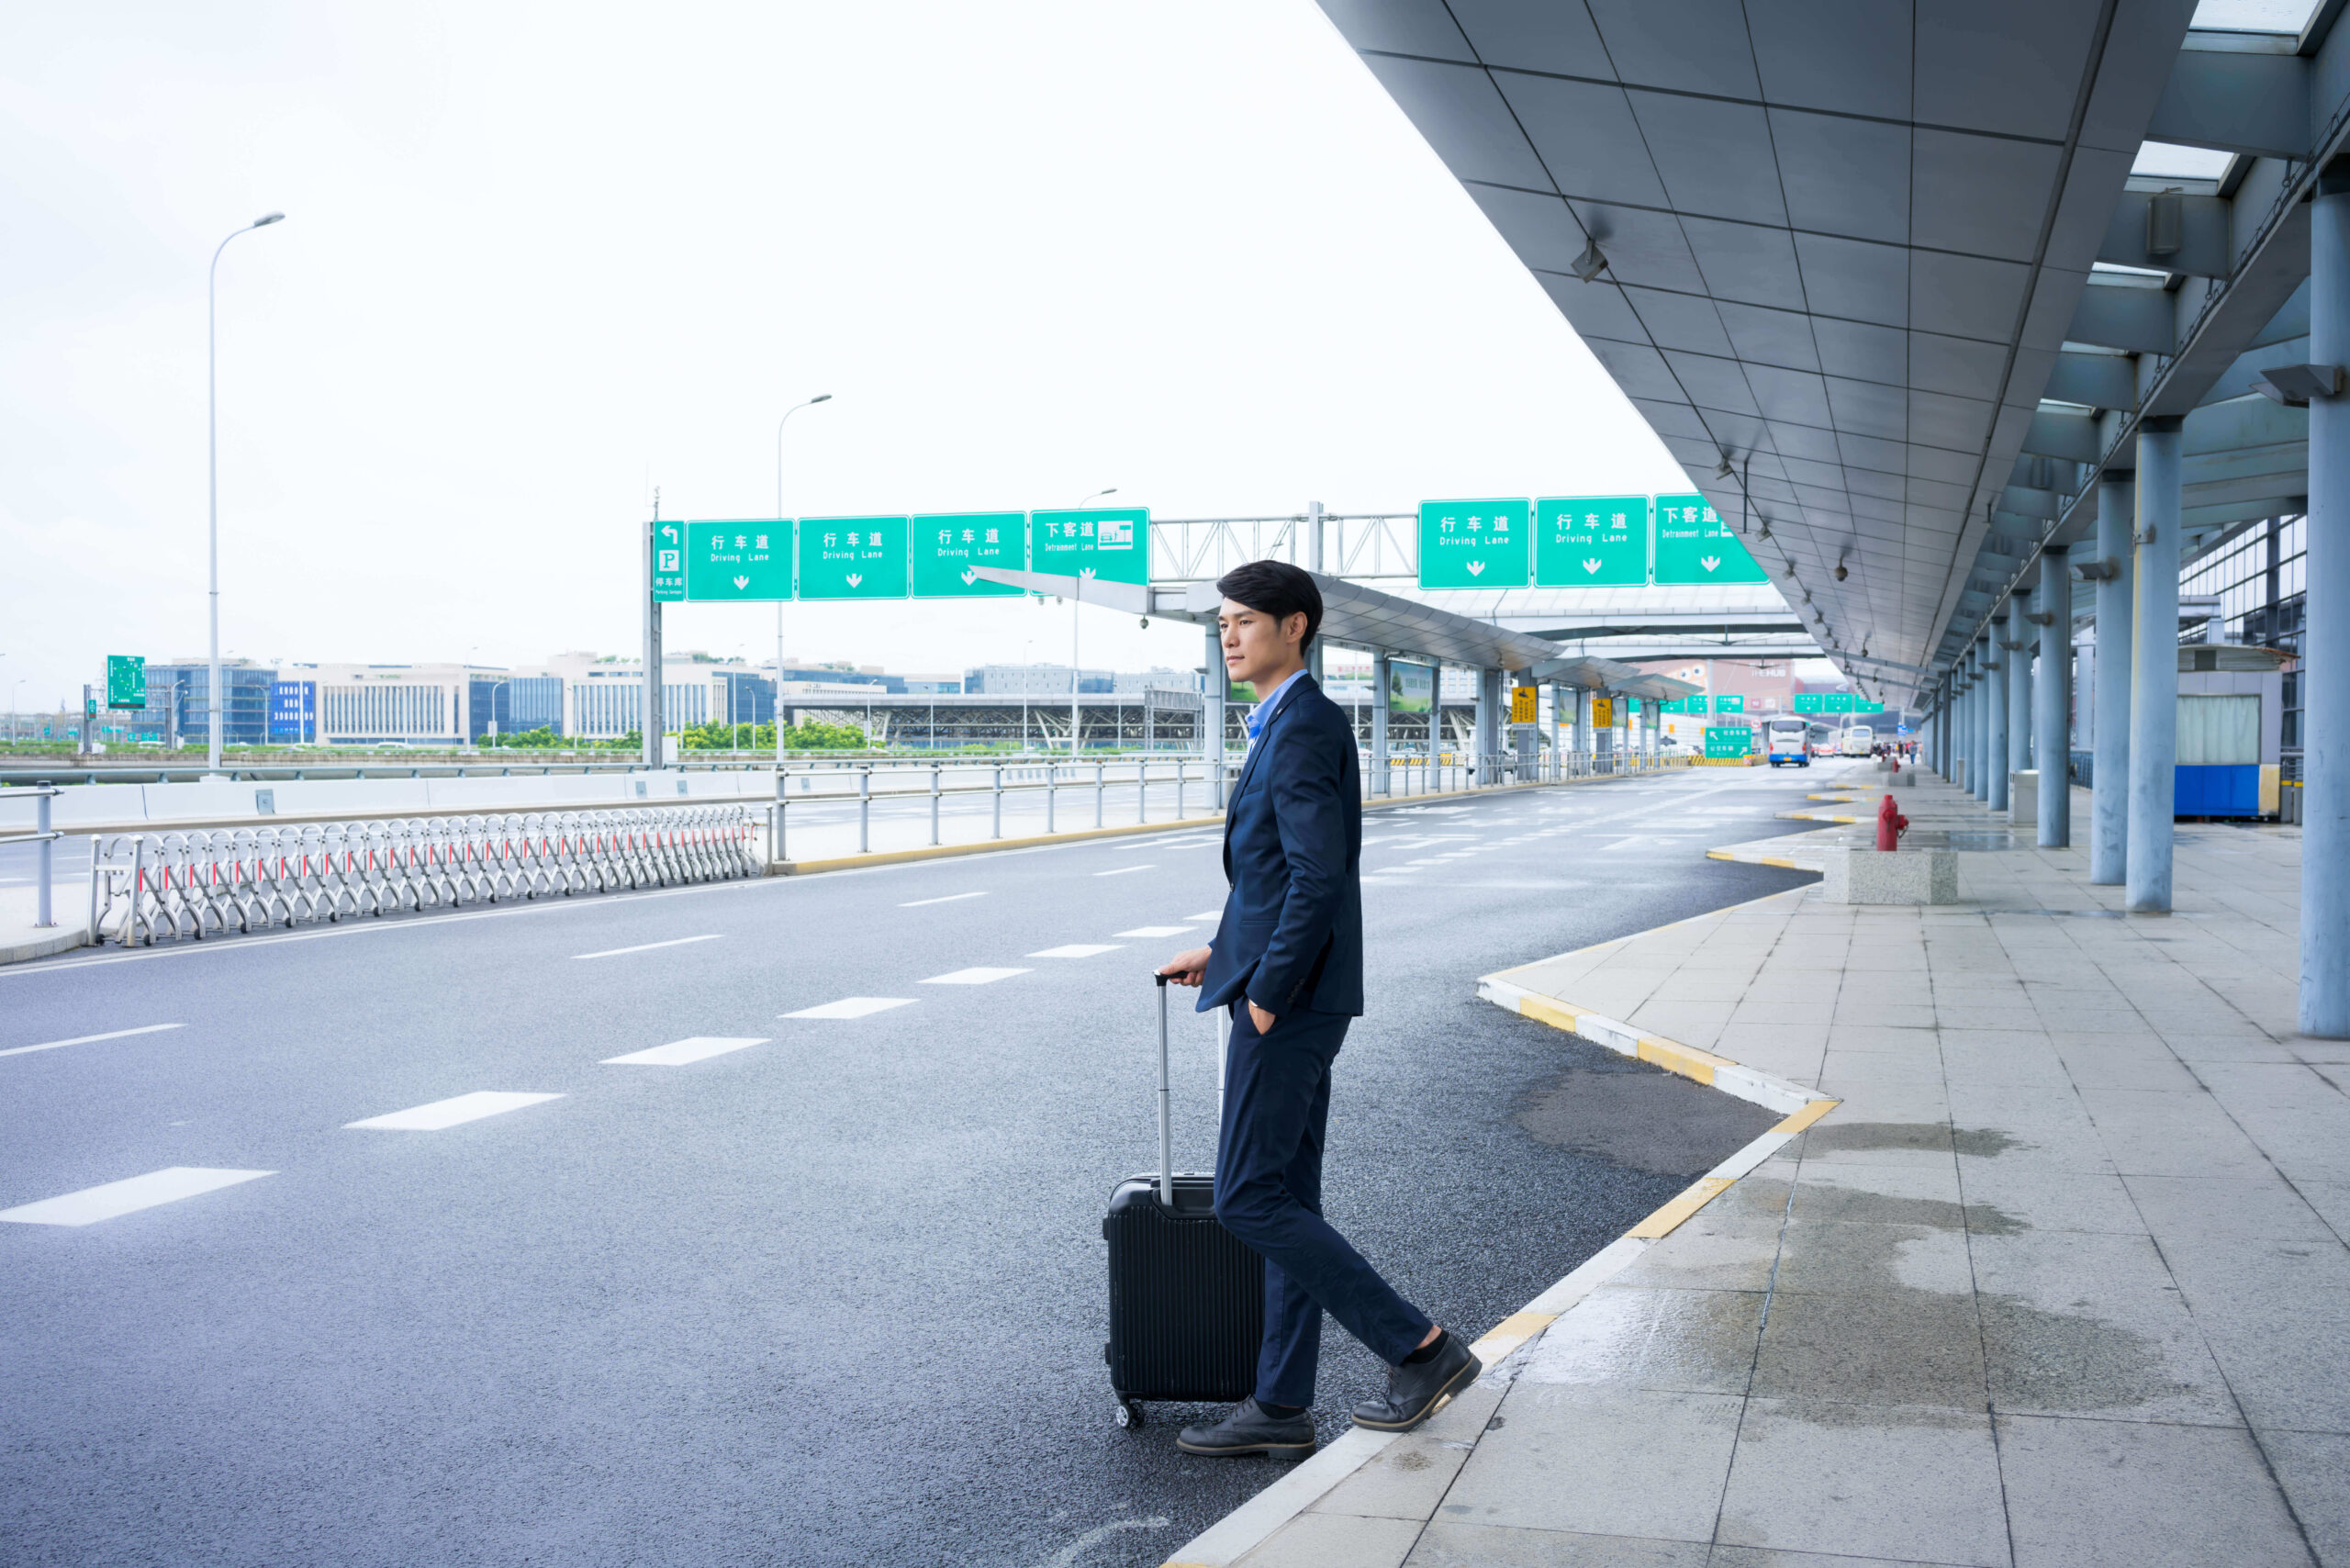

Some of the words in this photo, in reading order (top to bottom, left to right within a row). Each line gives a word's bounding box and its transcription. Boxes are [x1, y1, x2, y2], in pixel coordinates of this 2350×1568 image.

[1556, 512, 1628, 531] 行车道
[1662, 506, 1718, 523] 下客道
[1045, 521, 1094, 538] 下客道
[1440, 515, 1509, 532] 行车道
[823, 532, 882, 548] 行车道
[938, 528, 1000, 544] 行车道
[1439, 536, 1476, 547] Driving
[1484, 535, 1509, 544] Lane
[1556, 533, 1592, 545] Driving
[1602, 532, 1628, 543] Lane
[1705, 529, 1718, 538] Lane
[711, 534, 769, 550] 行车道
[1080, 543, 1094, 551] Lane
[711, 553, 741, 564] Driving
[748, 553, 769, 562] Lane
[822, 551, 855, 561] Driving
[861, 550, 883, 559] Lane
[937, 547, 969, 558] Driving
[978, 546, 1000, 555] Lane
[663, 553, 675, 568] P
